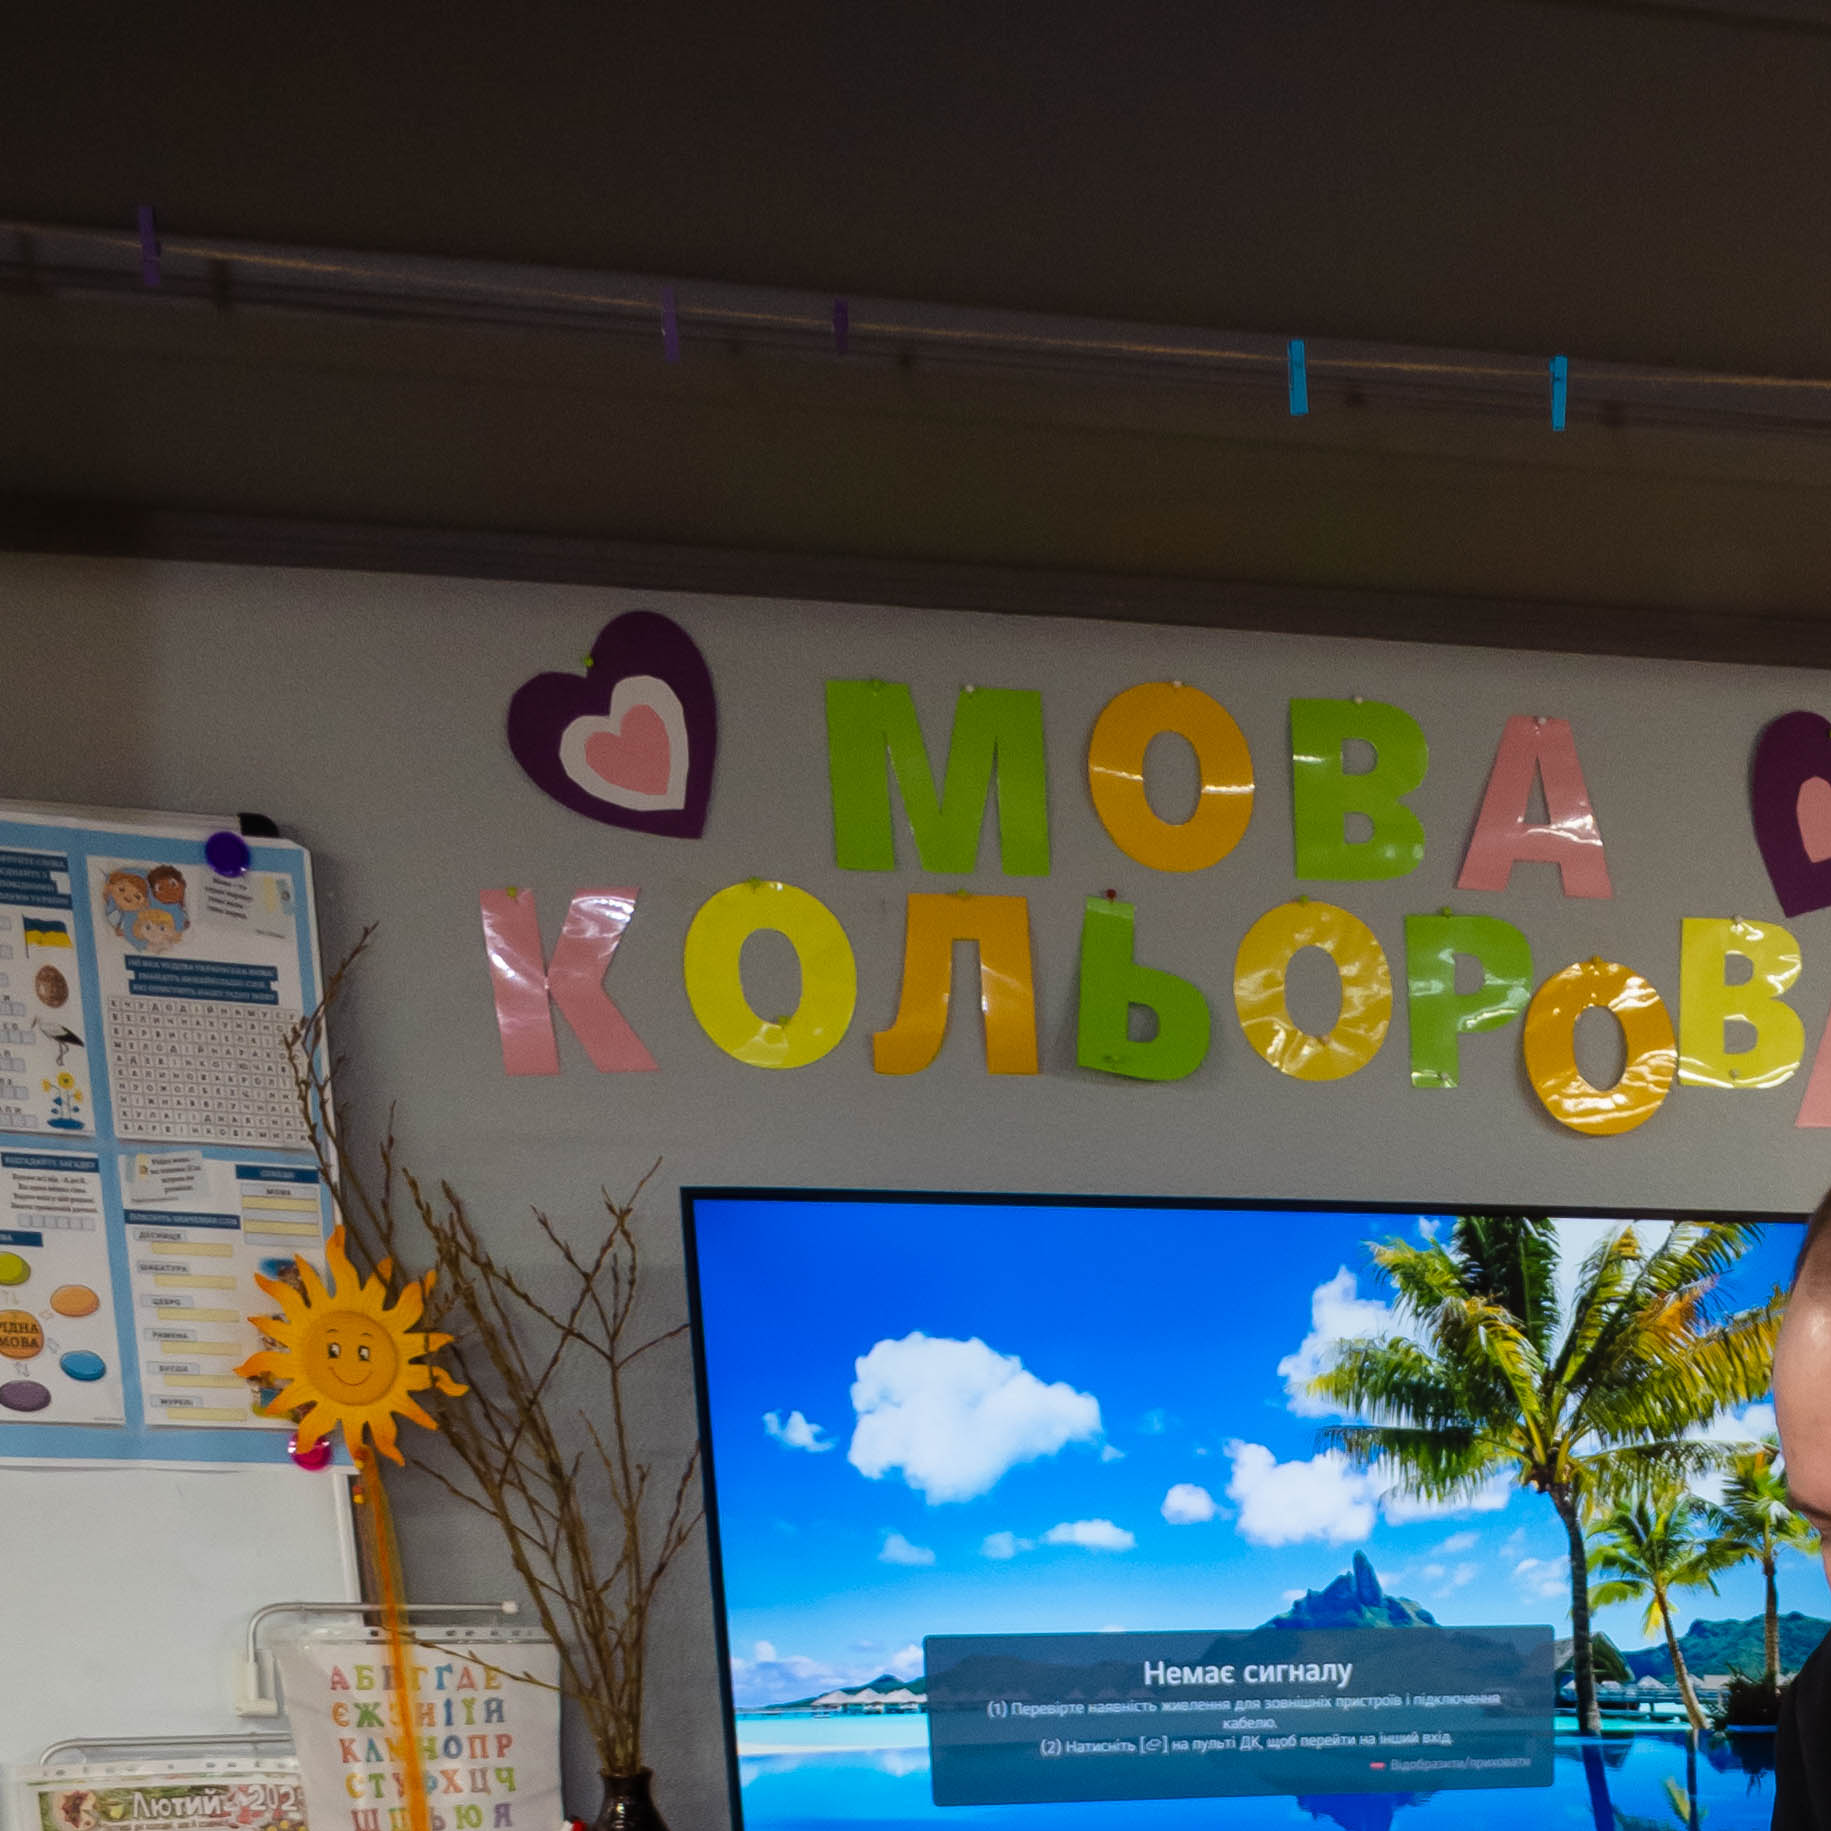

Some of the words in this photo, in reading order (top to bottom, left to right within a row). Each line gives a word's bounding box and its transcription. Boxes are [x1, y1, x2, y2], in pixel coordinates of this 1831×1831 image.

[824, 679, 1613, 898] МОВА
[1143, 1660, 1236, 1685] Немає
[1242, 1661, 1353, 1689] сигналу
[986, 1700, 1008, 1719] (1)
[1010, 1701, 1085, 1718] Перевірте
[1088, 1698, 1158, 1713] наявність
[1161, 1698, 1231, 1712] живлення
[1234, 1699, 1261, 1712] для
[1264, 1695, 1332, 1710] зовнішніх
[1335, 1693, 1403, 1711] пристроїв
[1413, 1693, 1502, 1708] підключення
[1222, 1716, 1278, 1730] кабелю.
[1040, 1738, 1062, 1757] (2)
[1065, 1738, 1137, 1754] Натисніть
[1172, 1739, 1189, 1750] на
[1192, 1736, 1236, 1754] пульті
[1266, 1733, 1296, 1749] щоб
[1299, 1734, 1356, 1749] перейти
[1359, 1734, 1376, 1746] на
[1379, 1731, 1419, 1746] інший
[133, 1788, 221, 1818] Лютий
